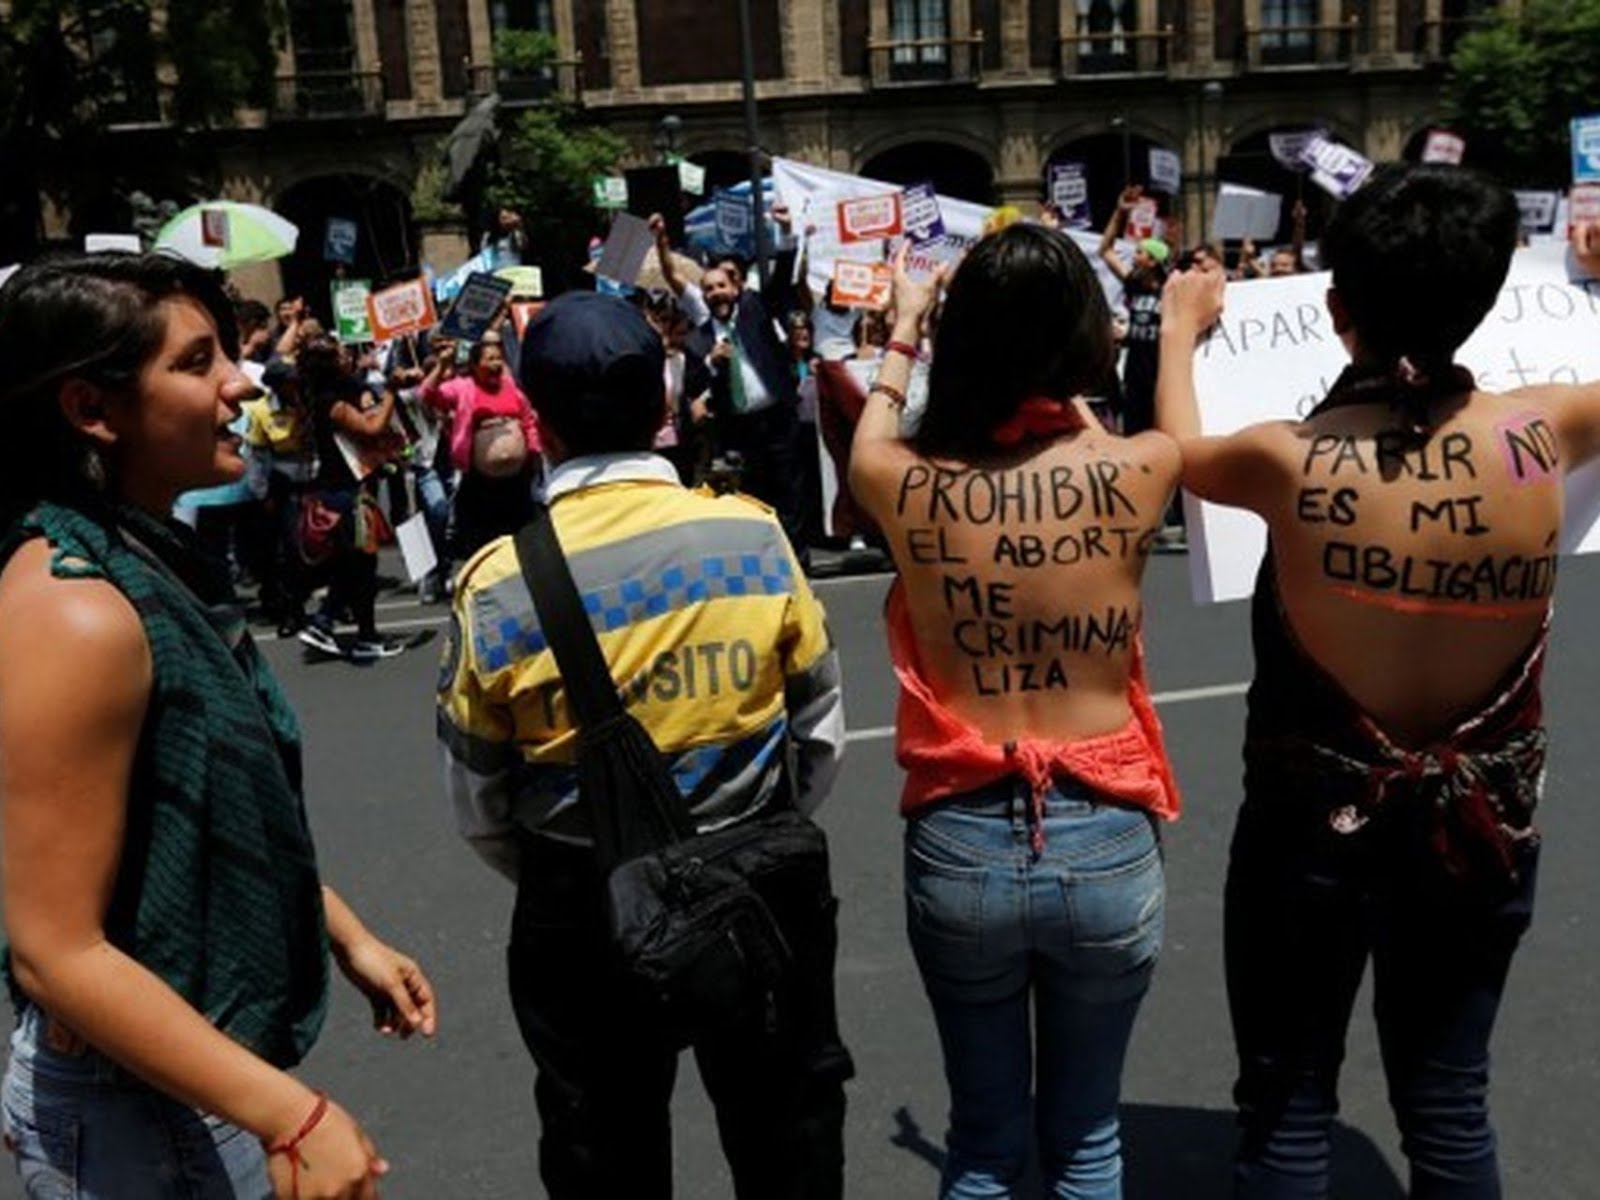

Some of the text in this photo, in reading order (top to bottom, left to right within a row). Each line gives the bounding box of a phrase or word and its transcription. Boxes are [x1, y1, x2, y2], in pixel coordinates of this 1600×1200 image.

[1303, 418, 1559, 482] PARIR NO
[896, 457, 1136, 525] PROHIBIR
[1297, 487, 1491, 537] ES MI
[907, 528, 968, 565] EL
[1322, 529, 1558, 602] OBLIGACIÓ
[943, 574, 1015, 620] ME
[537, 637, 758, 732] TNSITO
[972, 659, 1069, 696] LIZA
